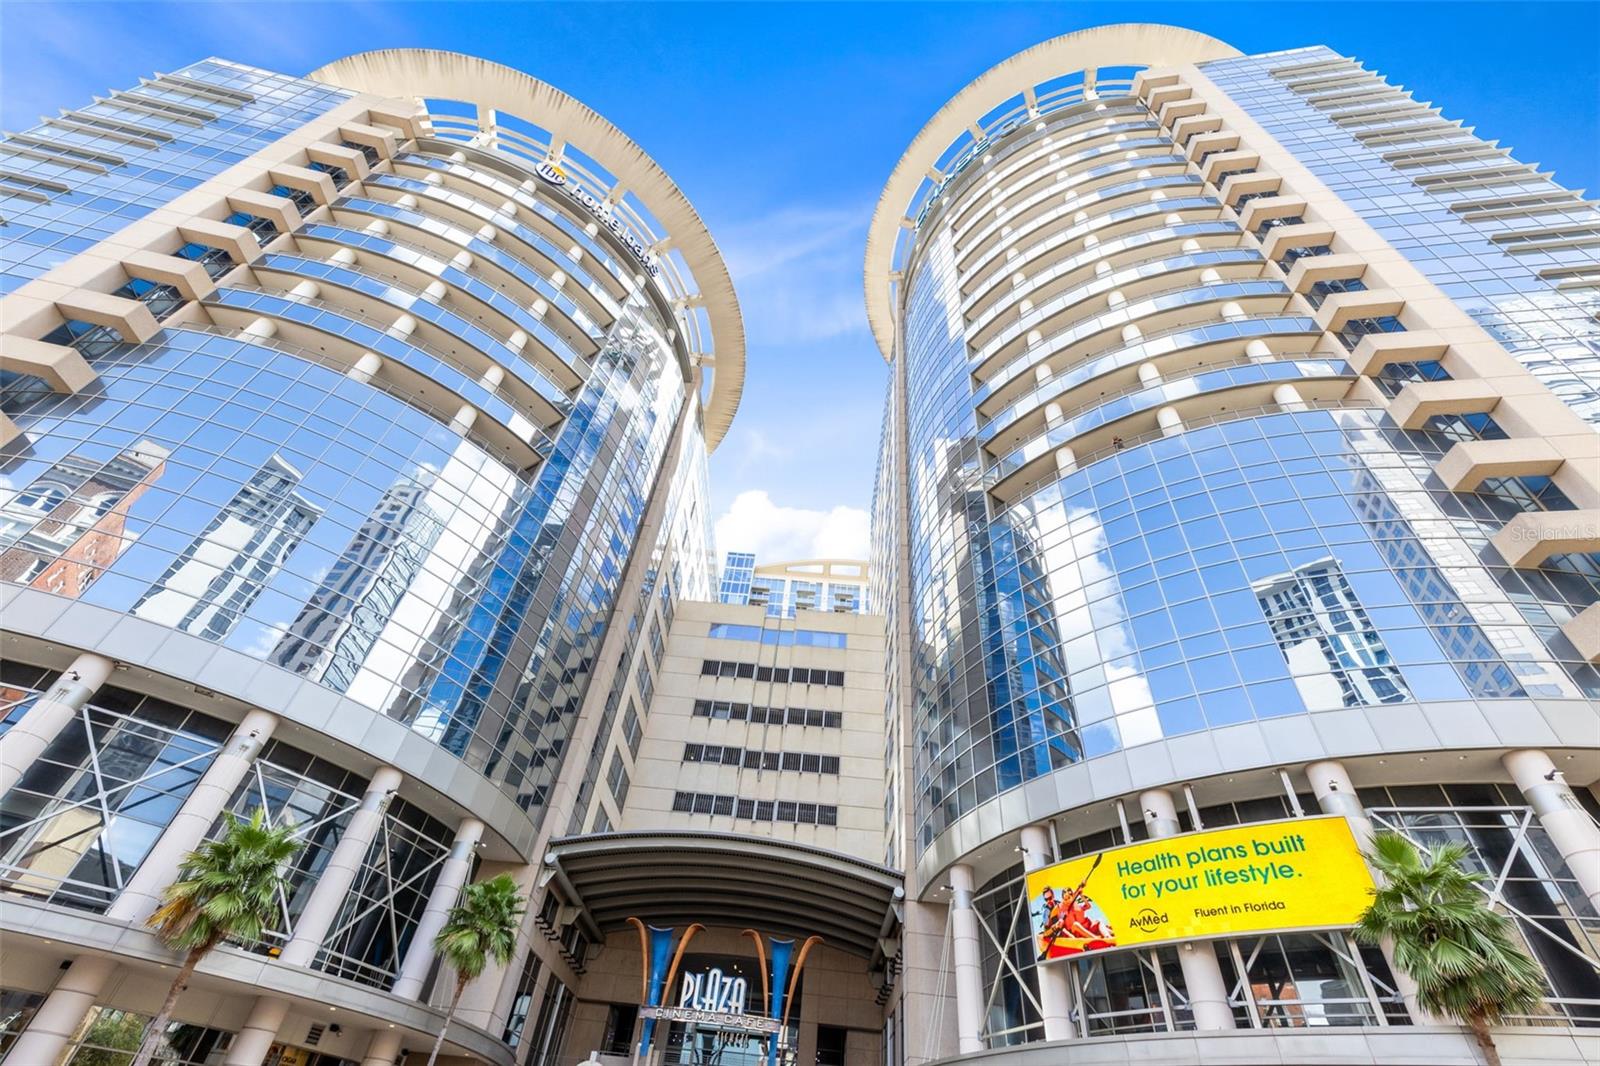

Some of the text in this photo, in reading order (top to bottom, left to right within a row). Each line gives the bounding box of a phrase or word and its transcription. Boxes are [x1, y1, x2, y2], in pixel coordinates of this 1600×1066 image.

[570, 182, 621, 233] home
[620, 226, 659, 278] loans
[1116, 834, 1306, 877] Health plans built
[1121, 862, 1303, 900] for your lifestyle.
[1129, 912, 1169, 929] AvMed
[1194, 900, 1286, 919] Fluent in Florida
[679, 967, 747, 1014] PLAZA
[655, 1007, 764, 1029] CINEMA CAFE
